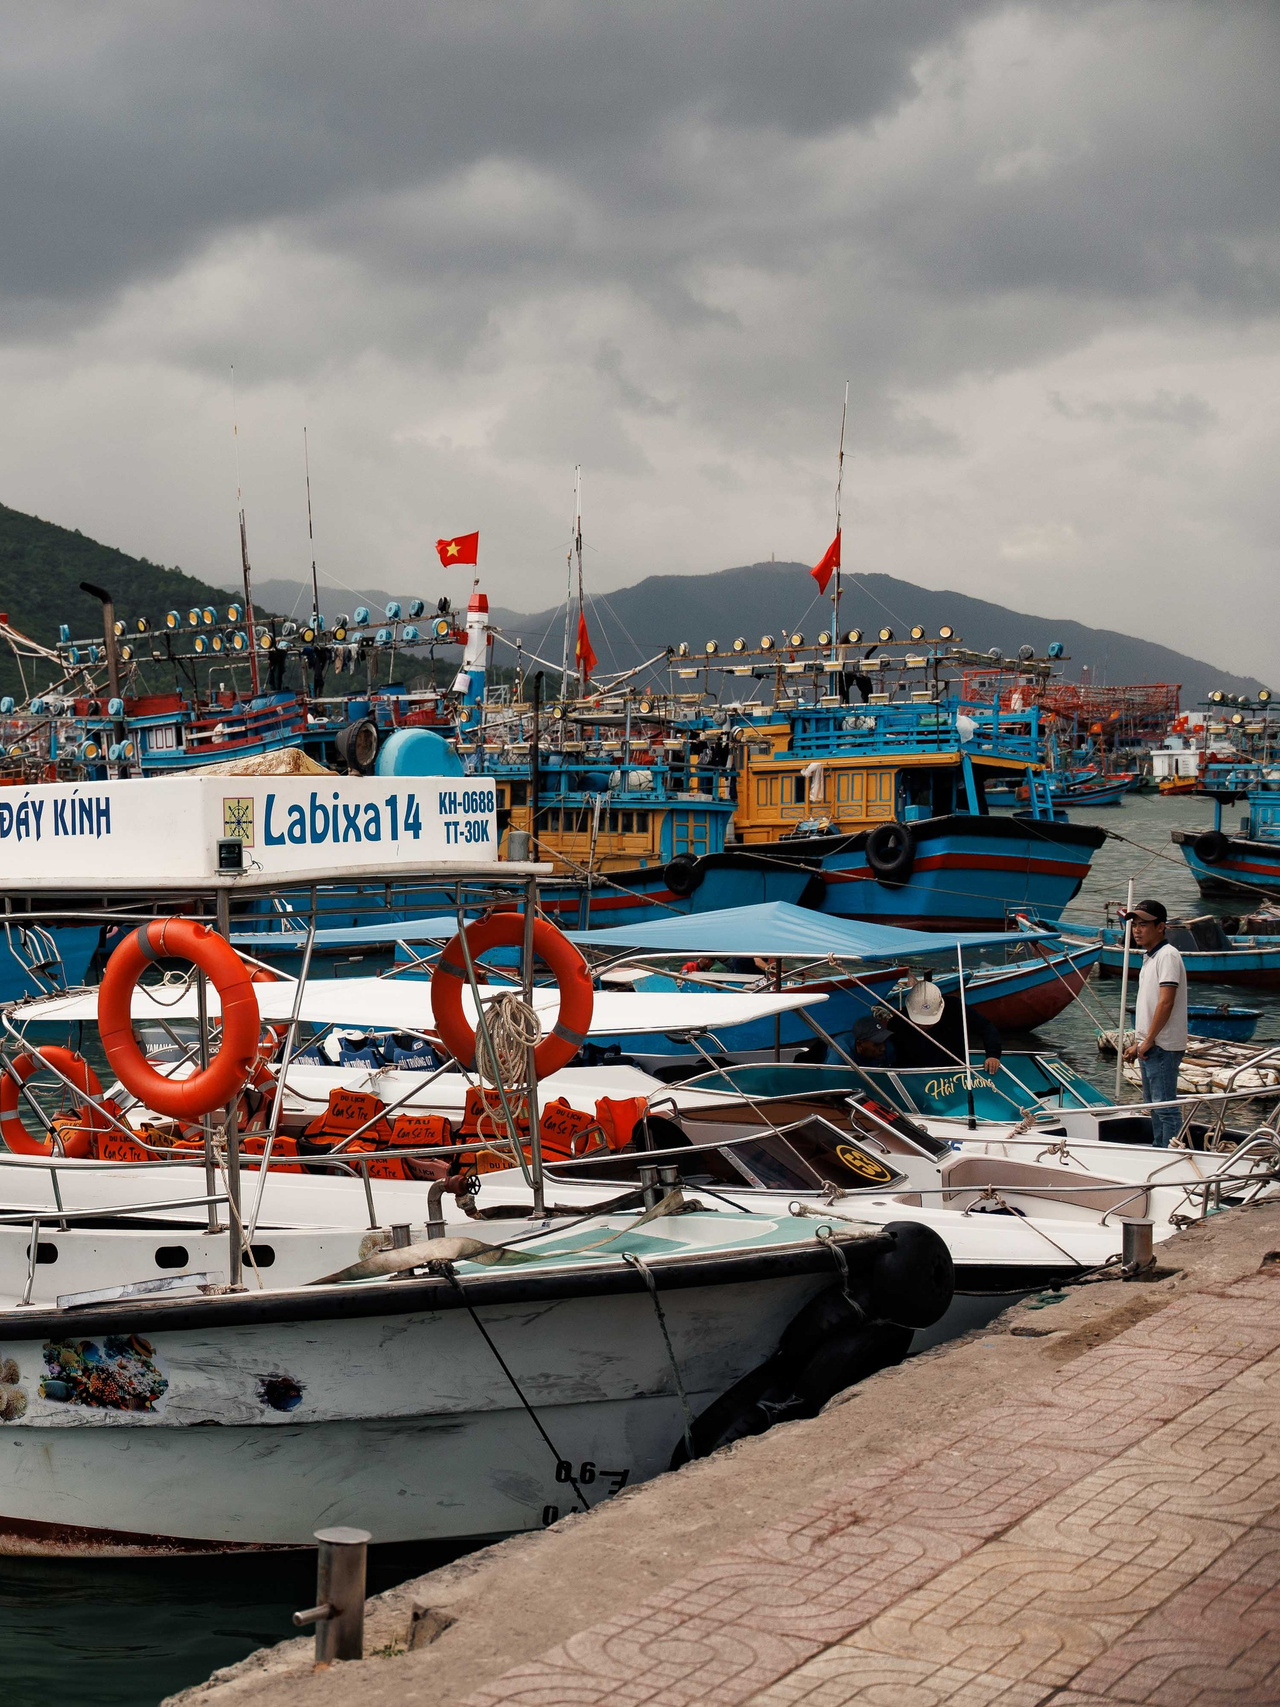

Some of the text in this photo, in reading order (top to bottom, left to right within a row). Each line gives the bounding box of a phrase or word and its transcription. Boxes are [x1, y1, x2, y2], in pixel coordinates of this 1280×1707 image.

[53, 788, 111, 840] KÍNH
[438, 790, 494, 815] KH-0688
[443, 819, 490, 844] TT-30K
[924, 1073, 996, 1100] Hải Tường
[843, 1150, 882, 1175] 53
